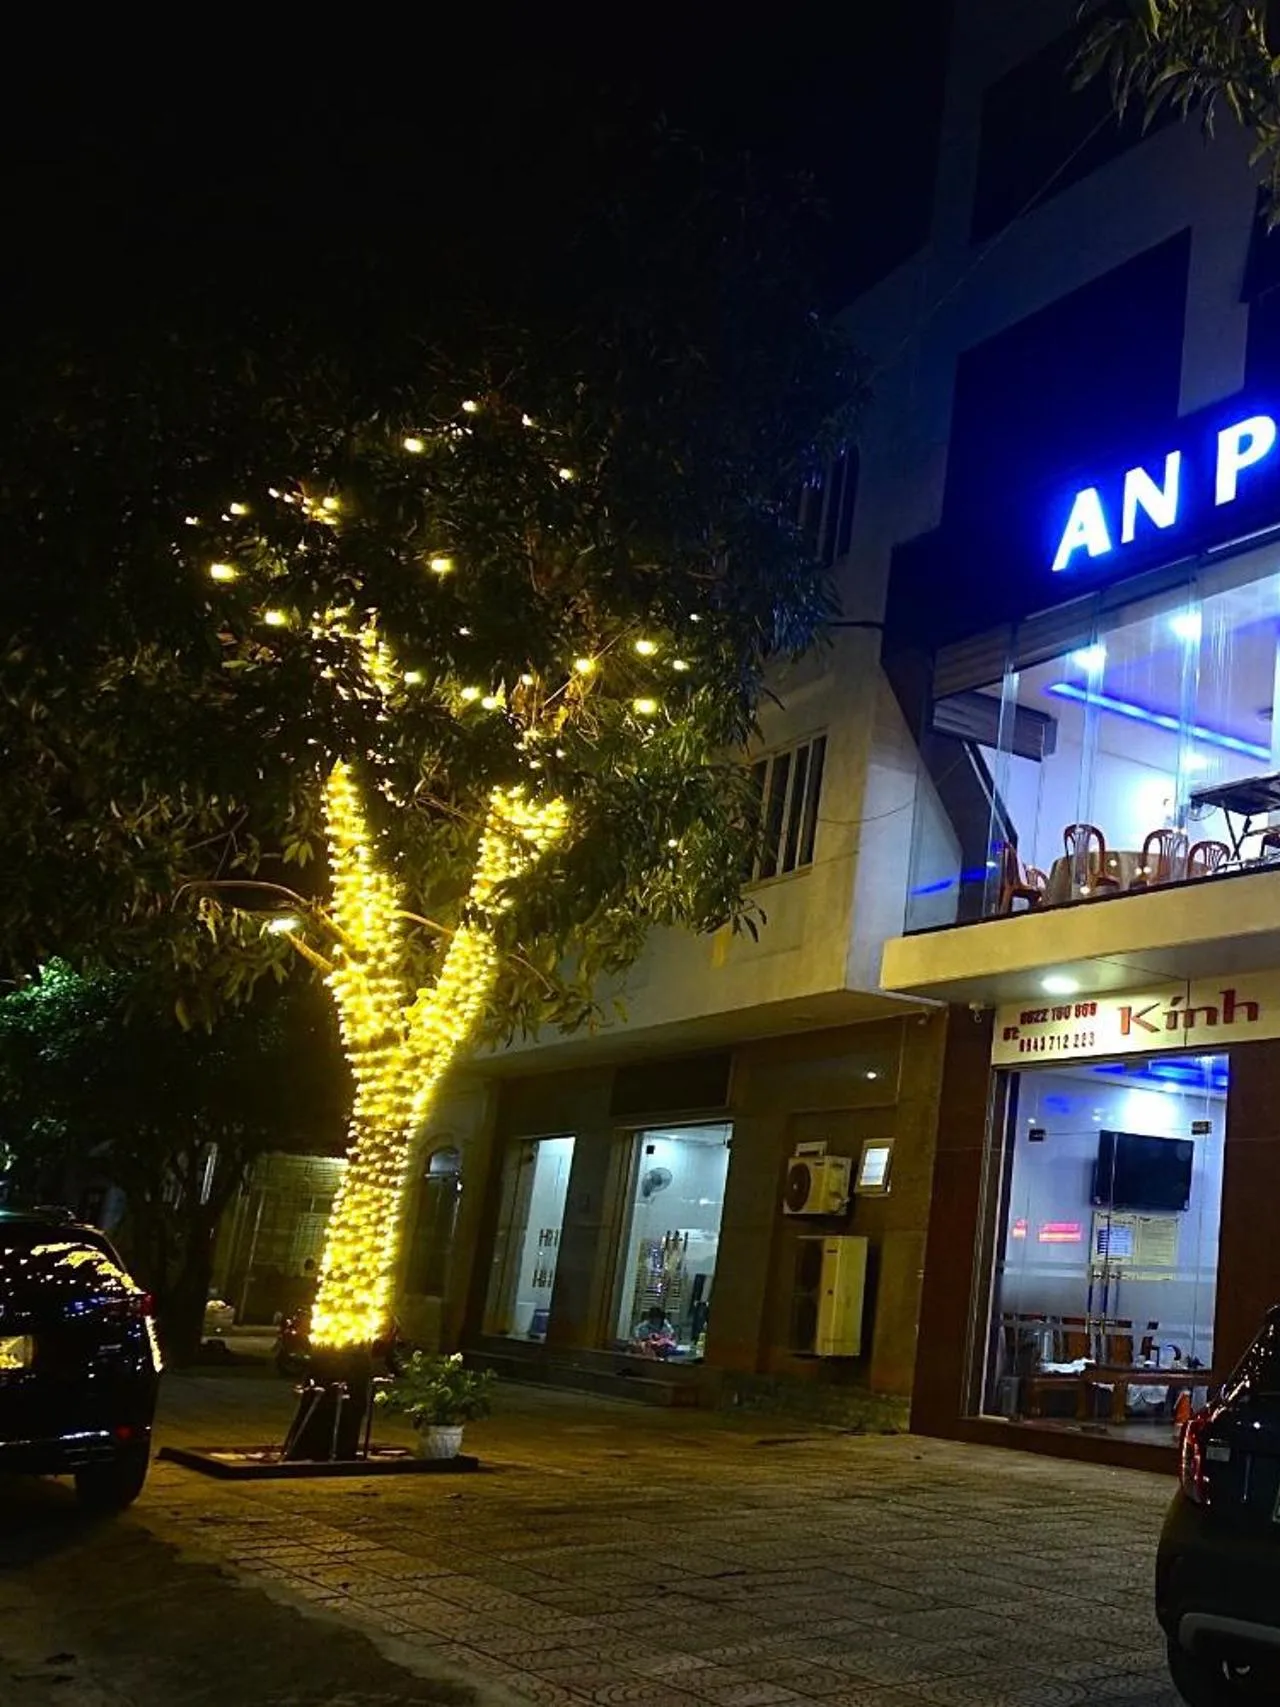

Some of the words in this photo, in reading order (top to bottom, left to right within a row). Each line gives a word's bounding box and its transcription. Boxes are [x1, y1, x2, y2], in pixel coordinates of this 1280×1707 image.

[1052, 450, 1181, 572] AN
[1117, 988, 1259, 1036] Kính
[1049, 1034, 1069, 1050] 712
